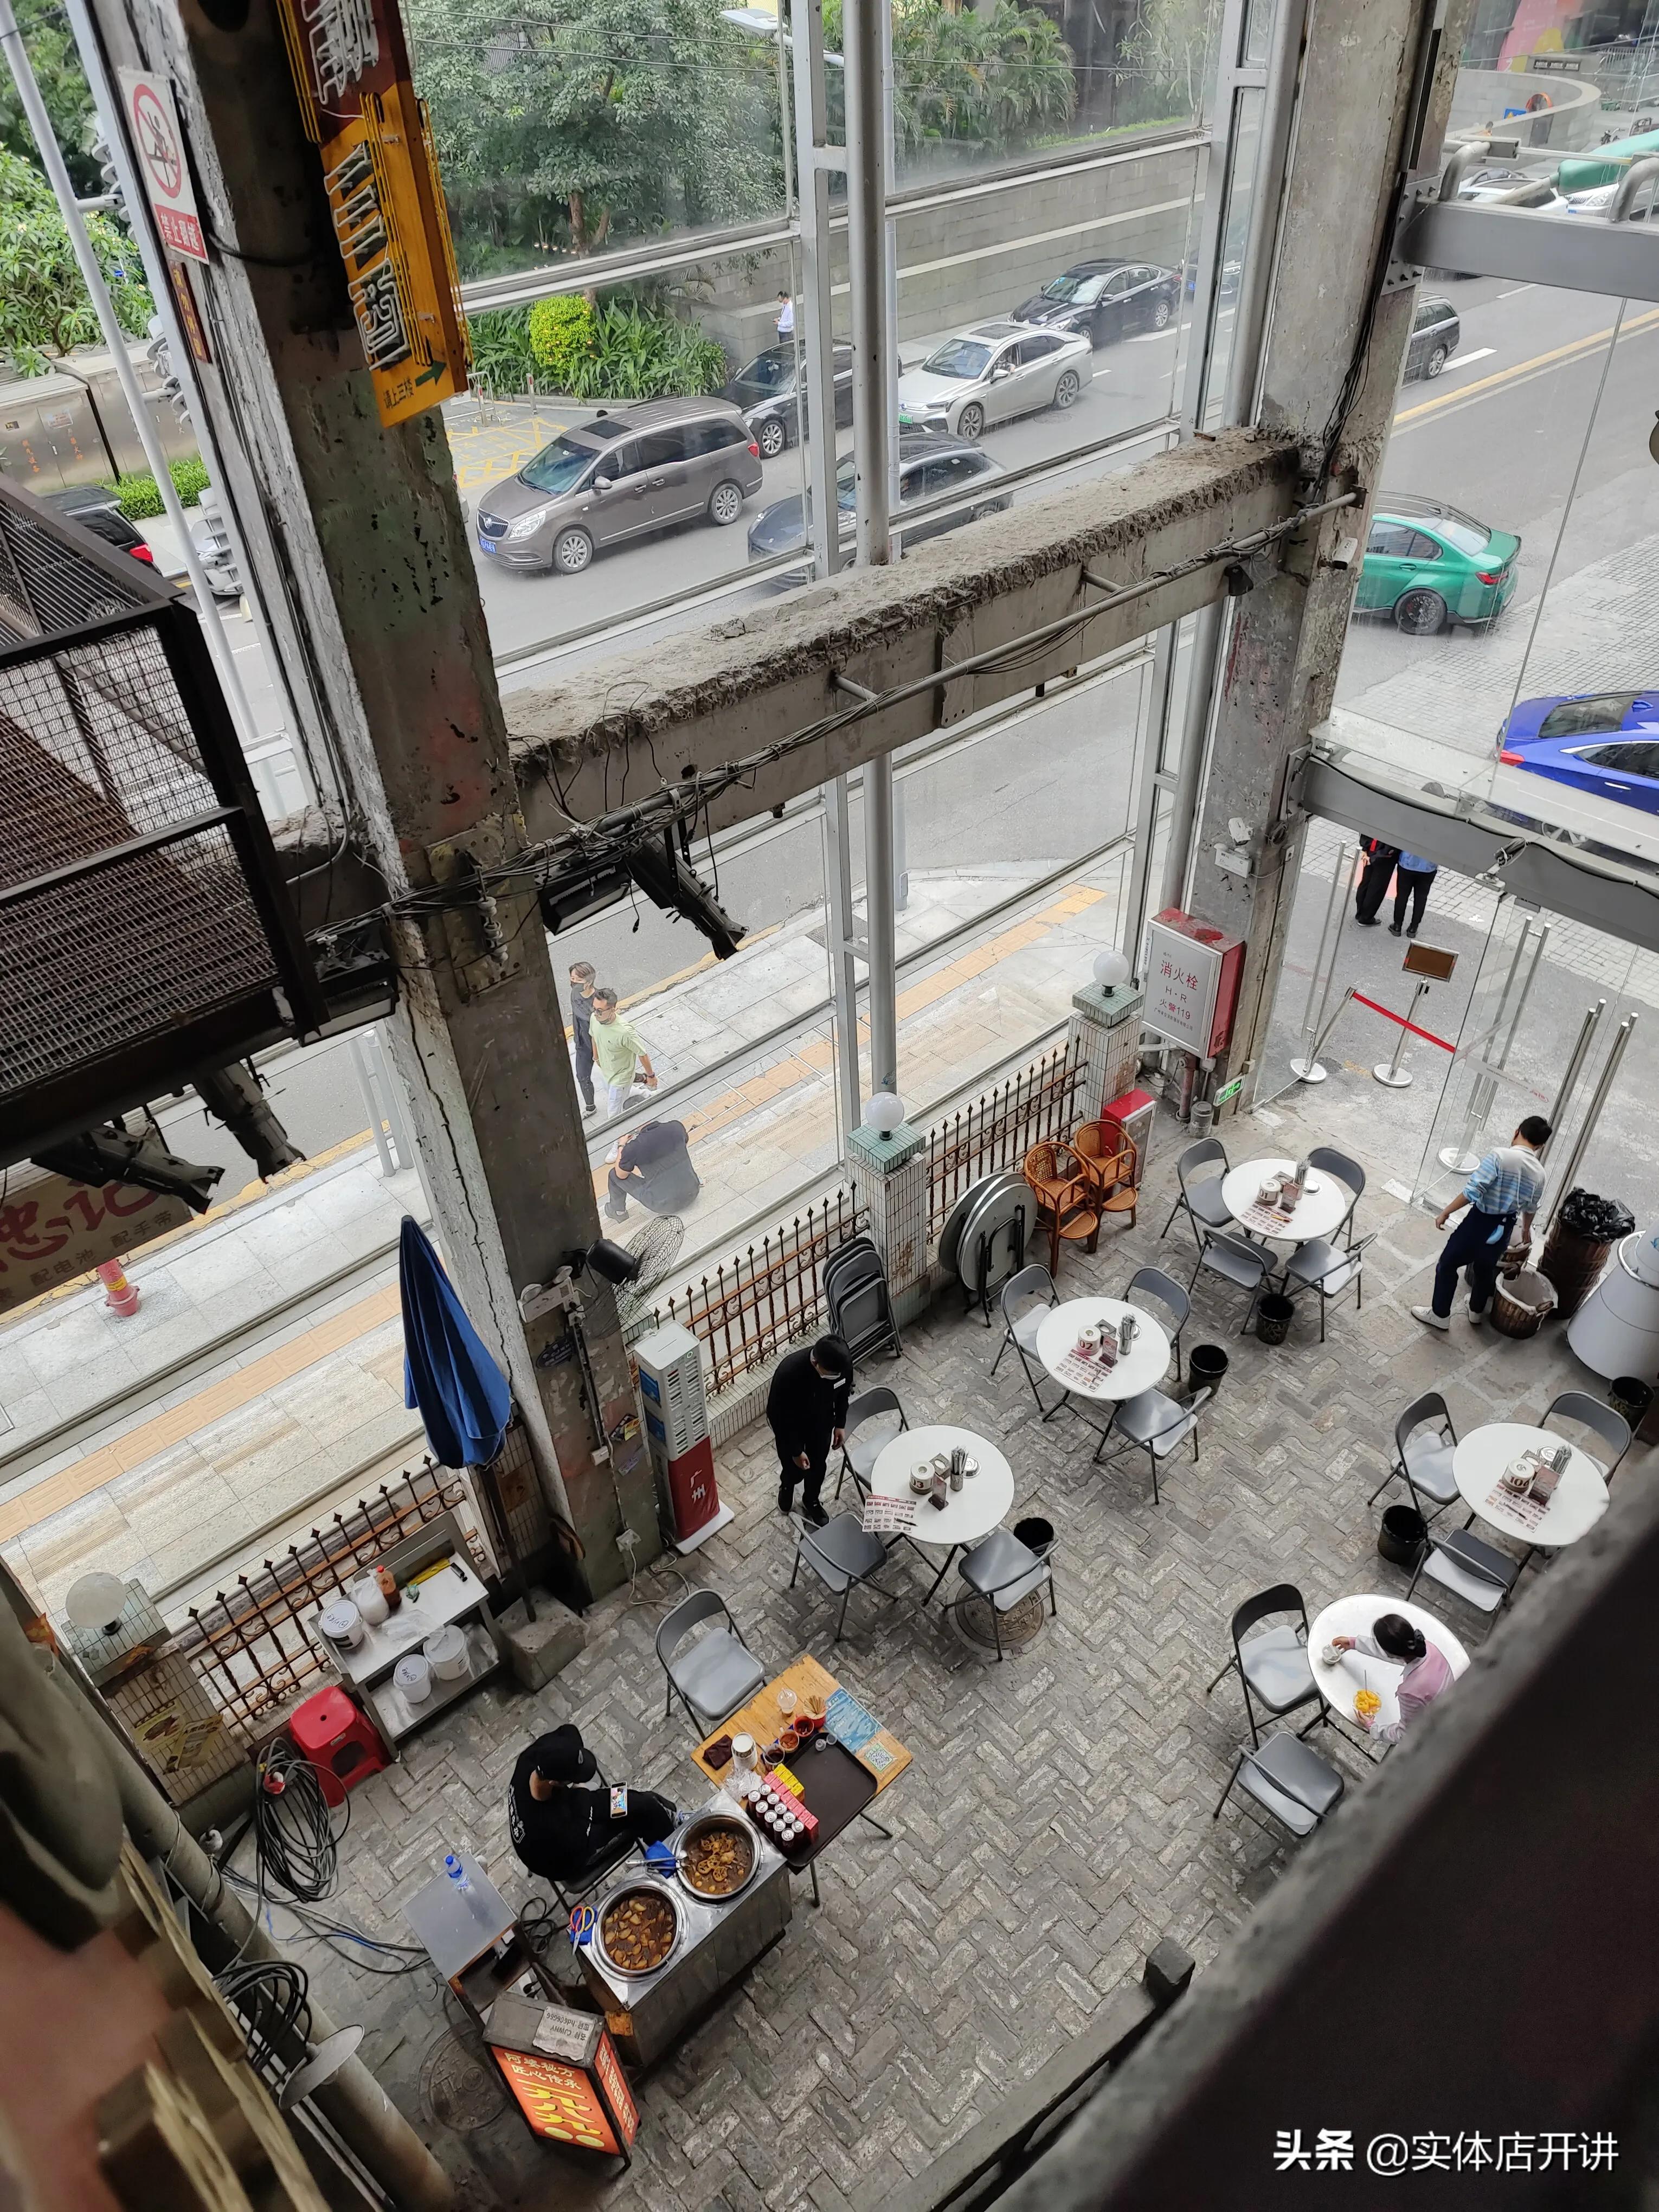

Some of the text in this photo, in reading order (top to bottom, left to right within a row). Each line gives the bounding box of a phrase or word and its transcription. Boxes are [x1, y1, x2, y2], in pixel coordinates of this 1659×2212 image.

[160, 212, 200, 252] 禁止翻越
[1160, 960, 1198, 991] 消火栓
[1159, 999, 1191, 1020] 火警119
[30, 1249, 98, 1287] 配电池
[504, 2052, 575, 2078] 阿婆秘方
[511, 2065, 582, 2090] 匠心传承
